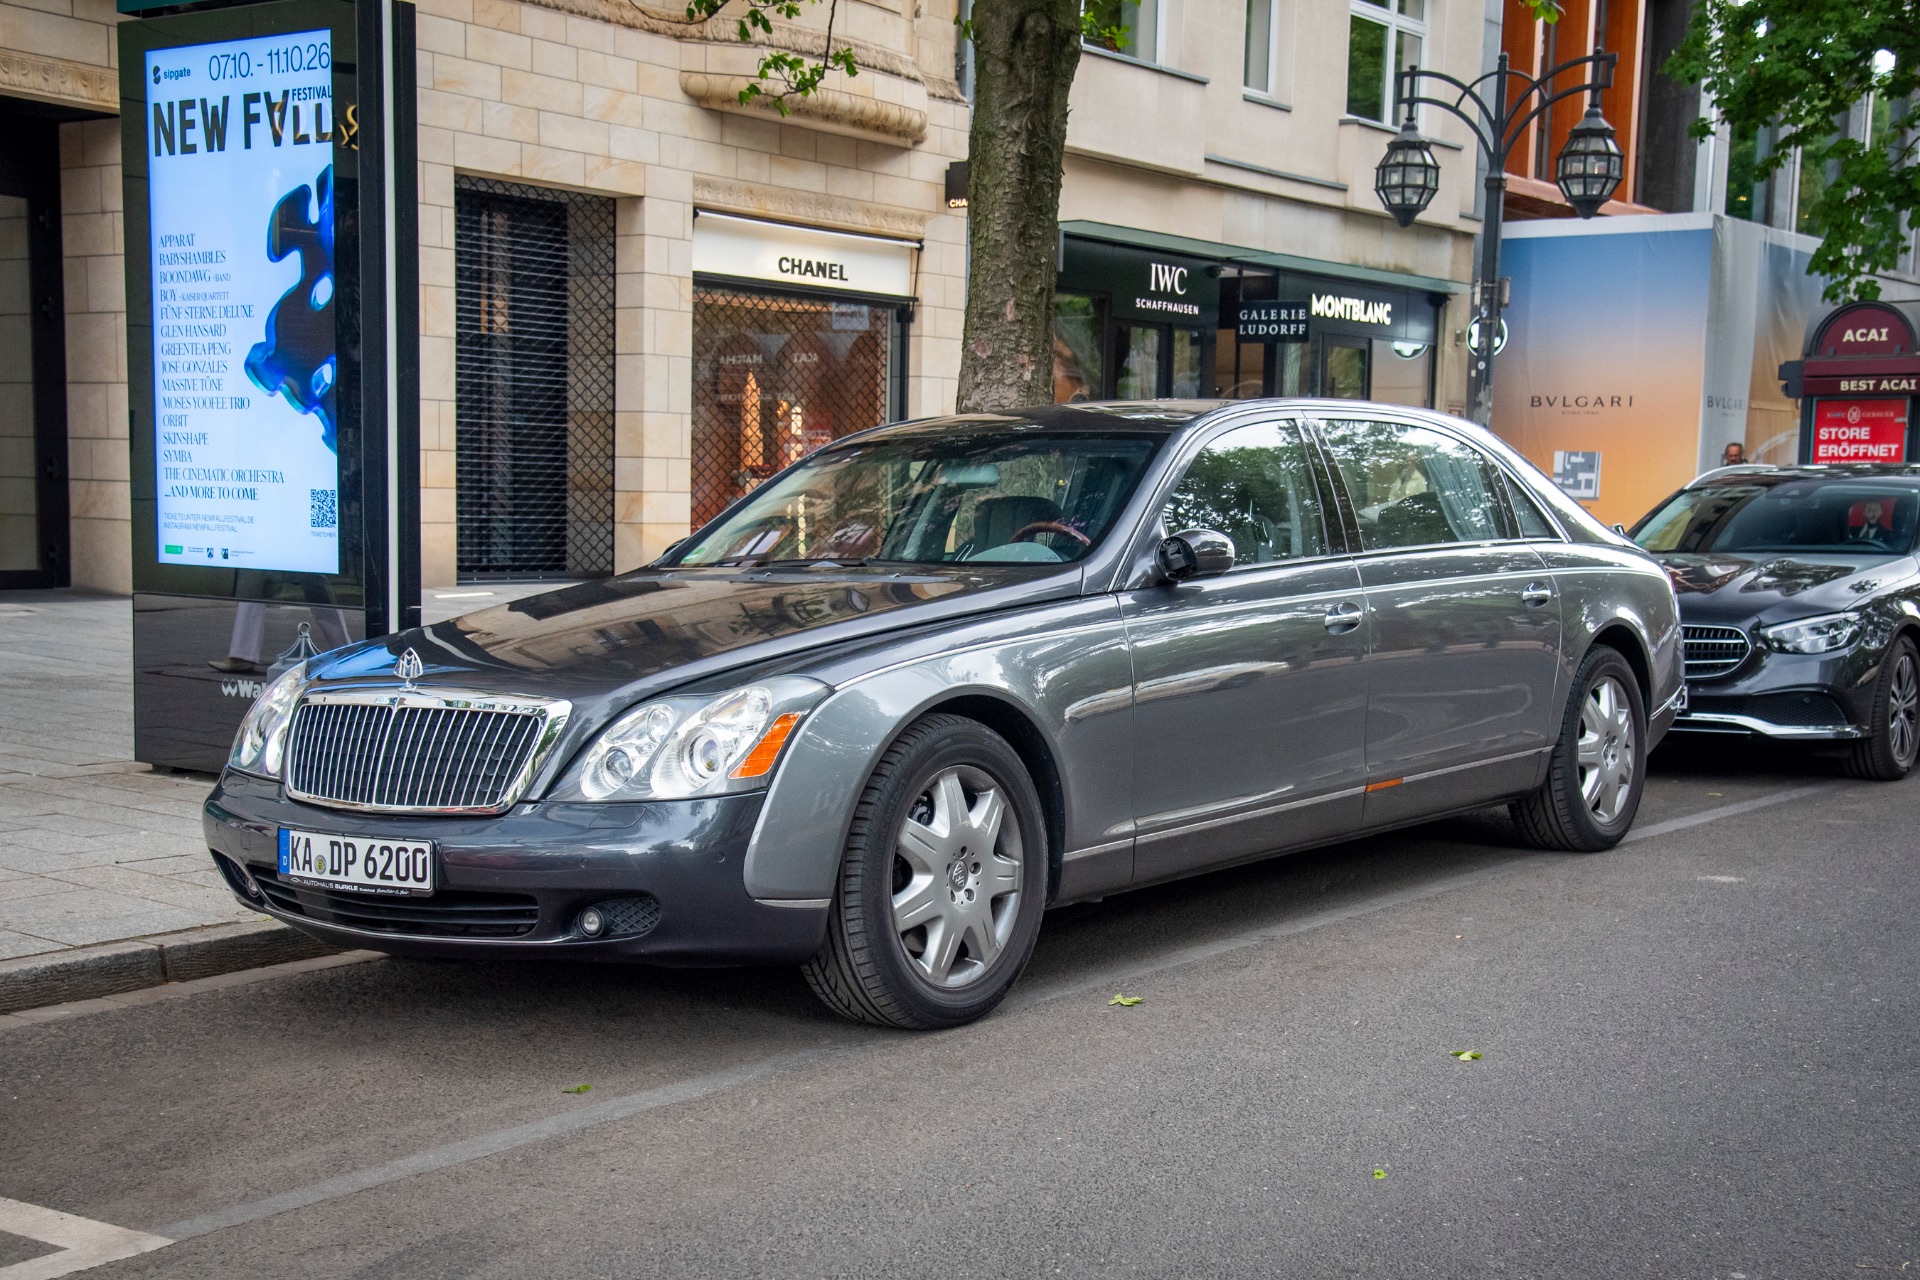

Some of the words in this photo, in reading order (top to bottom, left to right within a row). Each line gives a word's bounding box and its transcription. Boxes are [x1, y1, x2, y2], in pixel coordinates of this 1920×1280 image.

[267, 42, 330, 75] 11.10.26
[163, 67, 191, 81] sipgate
[291, 85, 332, 102] FESTIVAL
[153, 95, 229, 157] NEW
[949, 198, 969, 208] CHA
[159, 233, 195, 248] APPARAT
[159, 250, 226, 266] BABYSHAMBLES
[778, 256, 848, 281] CHANEL
[159, 269, 211, 284] BOONDAWG
[1149, 262, 1187, 295] IWC
[160, 289, 177, 302] BOY
[160, 304, 184, 320] FÜNF
[184, 306, 218, 320] STERNE
[219, 304, 254, 319] DELUXE
[1135, 298, 1199, 316] SCHAFFHAUSEN
[1311, 293, 1392, 326] MONTBLANC
[1239, 309, 1307, 321] GALERIE
[161, 324, 184, 338] GLEN
[185, 324, 227, 338] HANSARD
[1239, 324, 1307, 335] LUDORFF
[1843, 327, 1889, 343] ACAI
[161, 342, 206, 356] GREENTEA
[208, 342, 231, 356] PENG
[161, 358, 181, 375] JOSÉ
[182, 356, 228, 374] GONZÁLES
[162, 378, 199, 392] MASSIVE
[201, 376, 223, 392] TÖNE
[1840, 380, 1876, 392] BEST
[1879, 378, 1916, 391] ACAI
[162, 397, 191, 410] MOSES
[192, 397, 228, 410] YOOFEE
[229, 397, 250, 410] TRIO
[1530, 395, 1633, 408] BVLGARI
[162, 414, 188, 427] ORBIT
[163, 432, 209, 445] SKINSHAPE
[1819, 427, 1870, 440] STORE
[163, 450, 192, 463] SYMBA
[1818, 441, 1899, 457] ERÖFFNET
[164, 467, 181, 481] THE
[183, 467, 230, 482] CINEMATIC
[231, 469, 284, 484] ORCHESTRA
[190, 486, 216, 500] MORE
[218, 487, 230, 500] TO
[231, 487, 258, 501] COME
[291, 835, 312, 873] KA
[329, 840, 357, 876] DP
[364, 844, 427, 883] 6200
